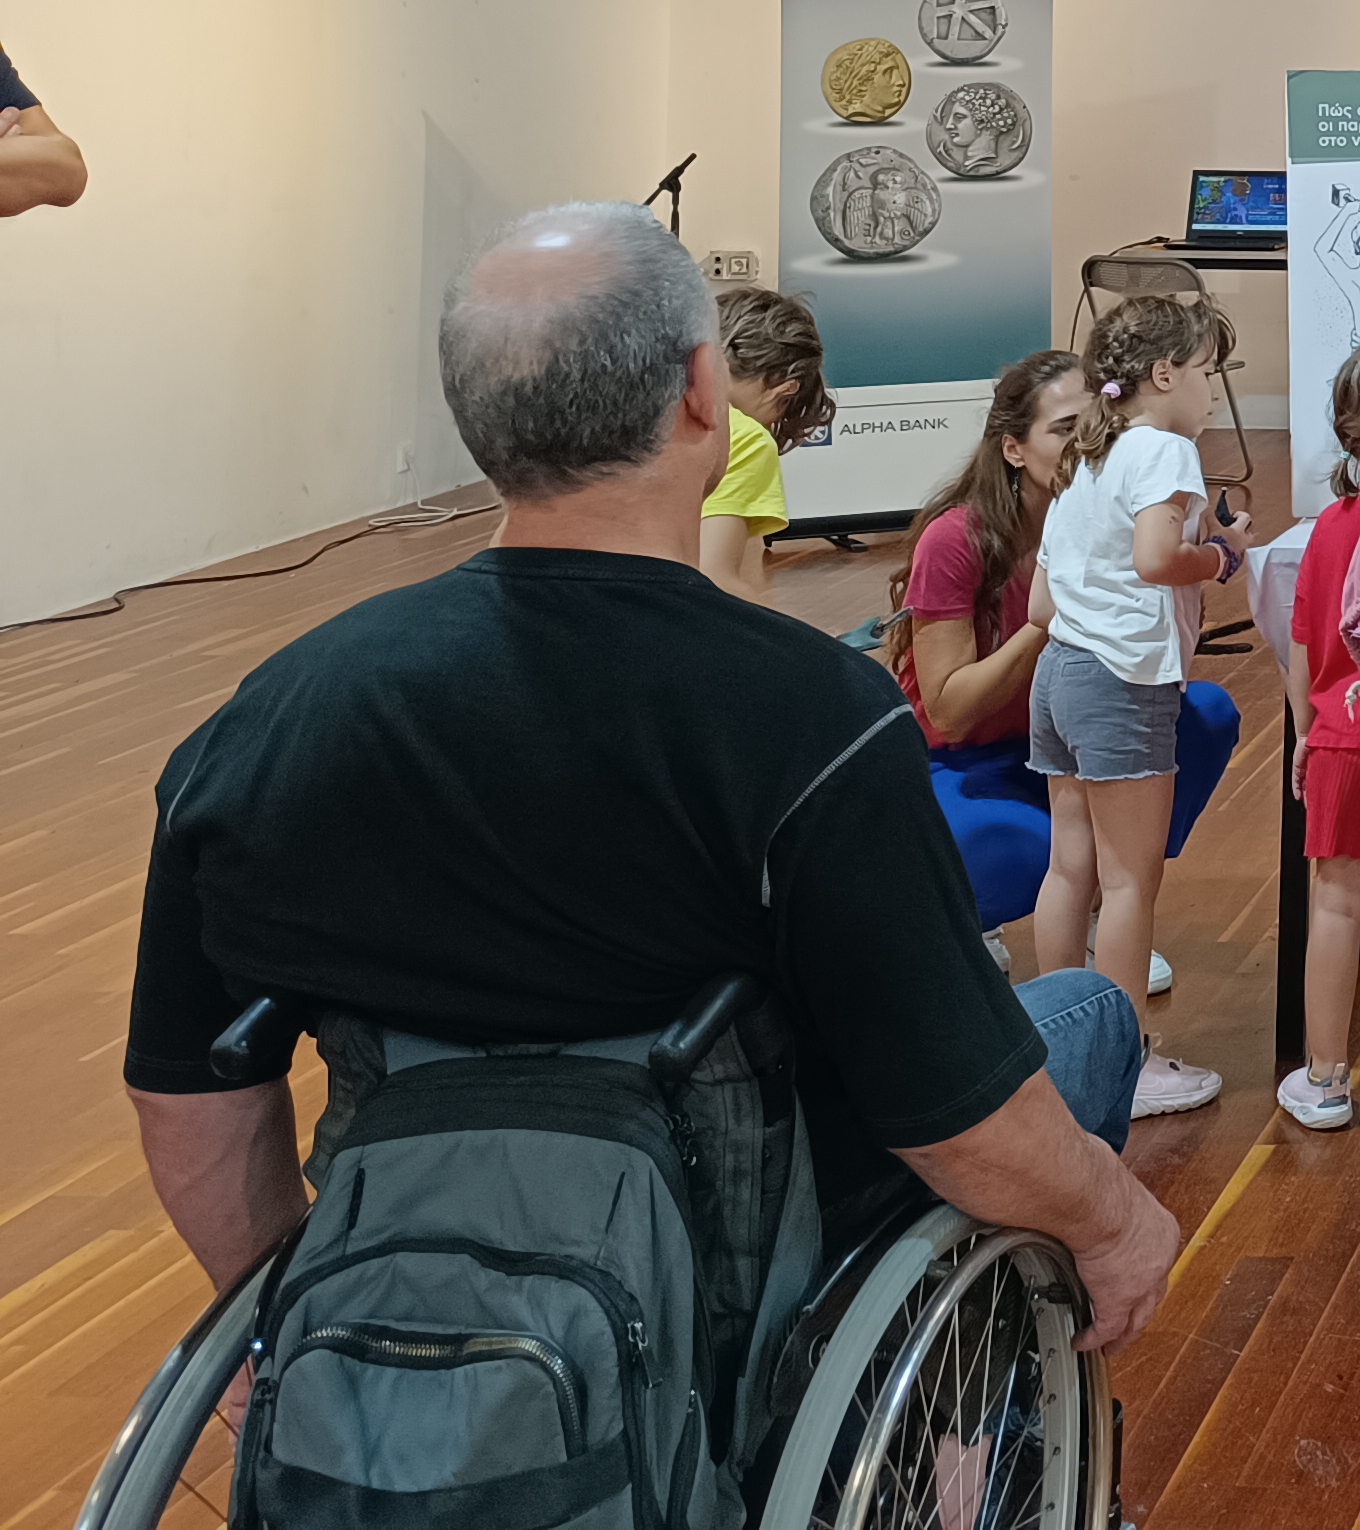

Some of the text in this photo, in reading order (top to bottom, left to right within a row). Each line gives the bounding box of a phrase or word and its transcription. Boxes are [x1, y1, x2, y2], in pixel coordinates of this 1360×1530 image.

[1318, 103, 1352, 120] Πώς
[1318, 121, 1333, 132] οι
[1318, 135, 1347, 147] στο
[839, 417, 949, 436] ALPHA BANK
